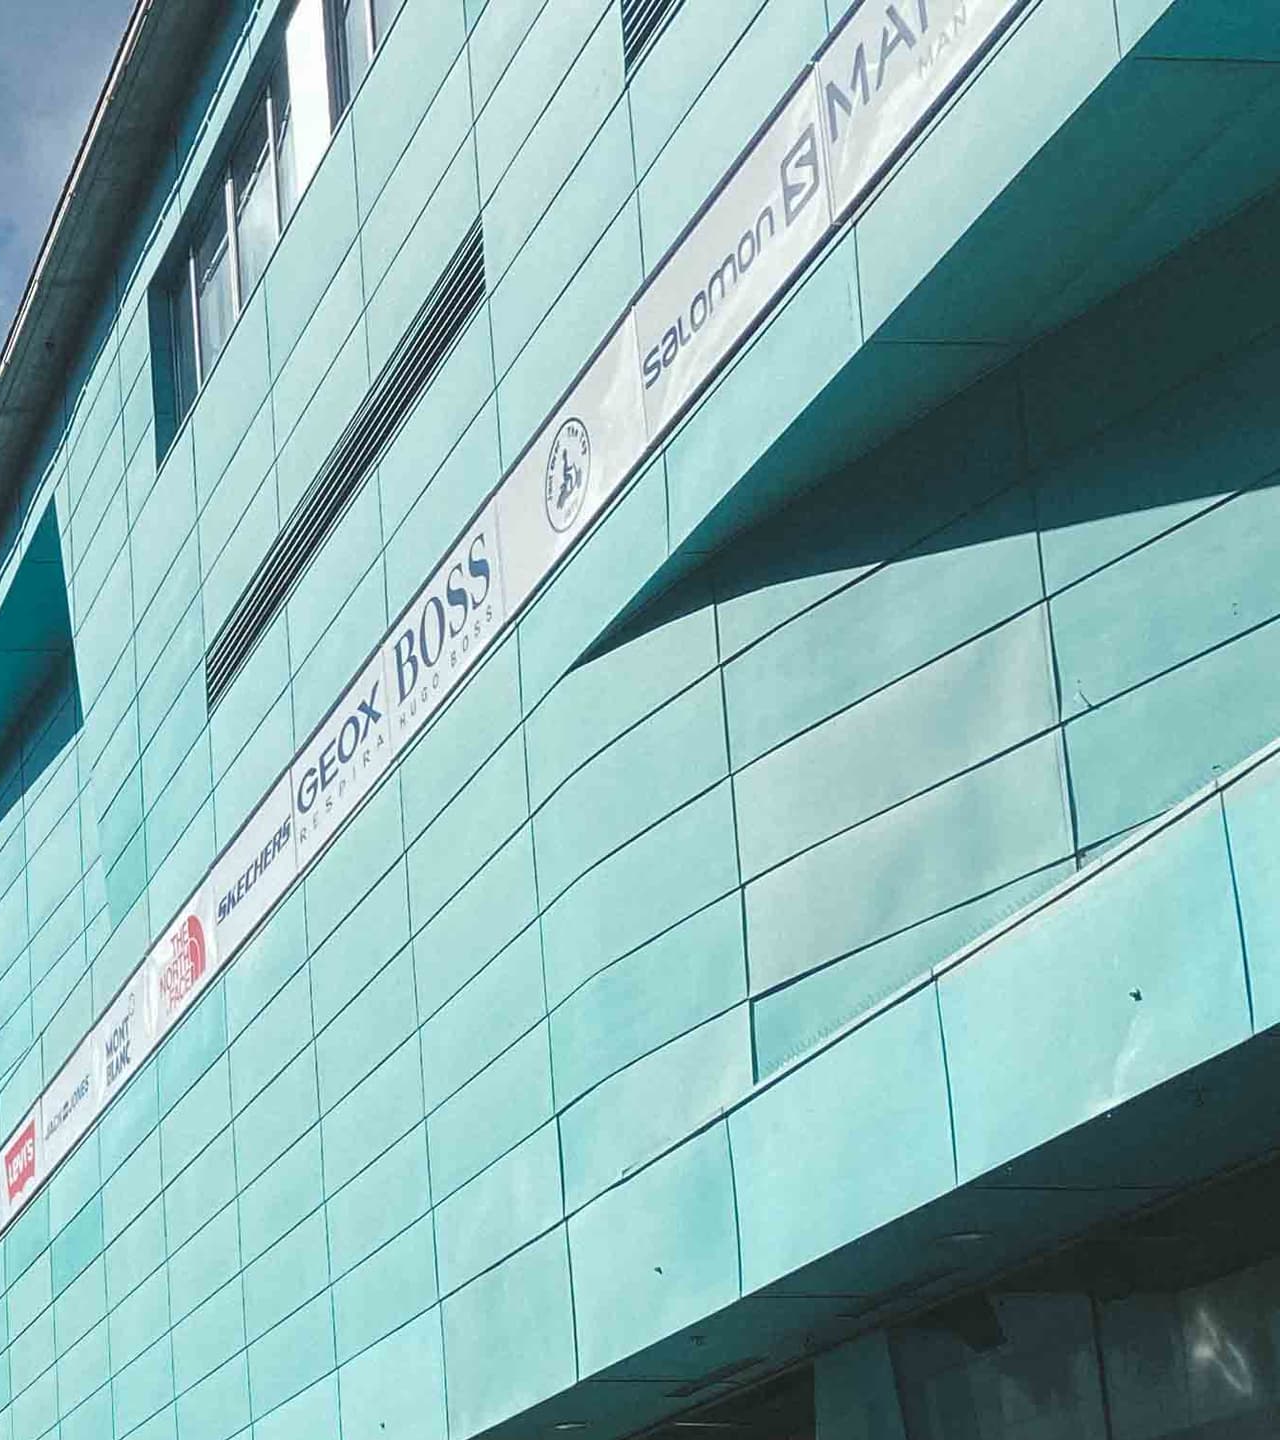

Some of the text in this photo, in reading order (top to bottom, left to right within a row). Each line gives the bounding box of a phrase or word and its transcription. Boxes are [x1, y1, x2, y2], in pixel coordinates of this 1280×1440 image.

[394, 533, 490, 706] BOSS
[399, 605, 492, 728] HUGO BOSS
[297, 680, 383, 813] GEOX
[299, 734, 385, 844] RESPIRA
[216, 814, 291, 926] SKECHERS
[160, 953, 191, 997] NORTH
[171, 921, 189, 956] THE
[105, 1016, 129, 1058] MONT
[106, 1040, 131, 1086] BLANC
